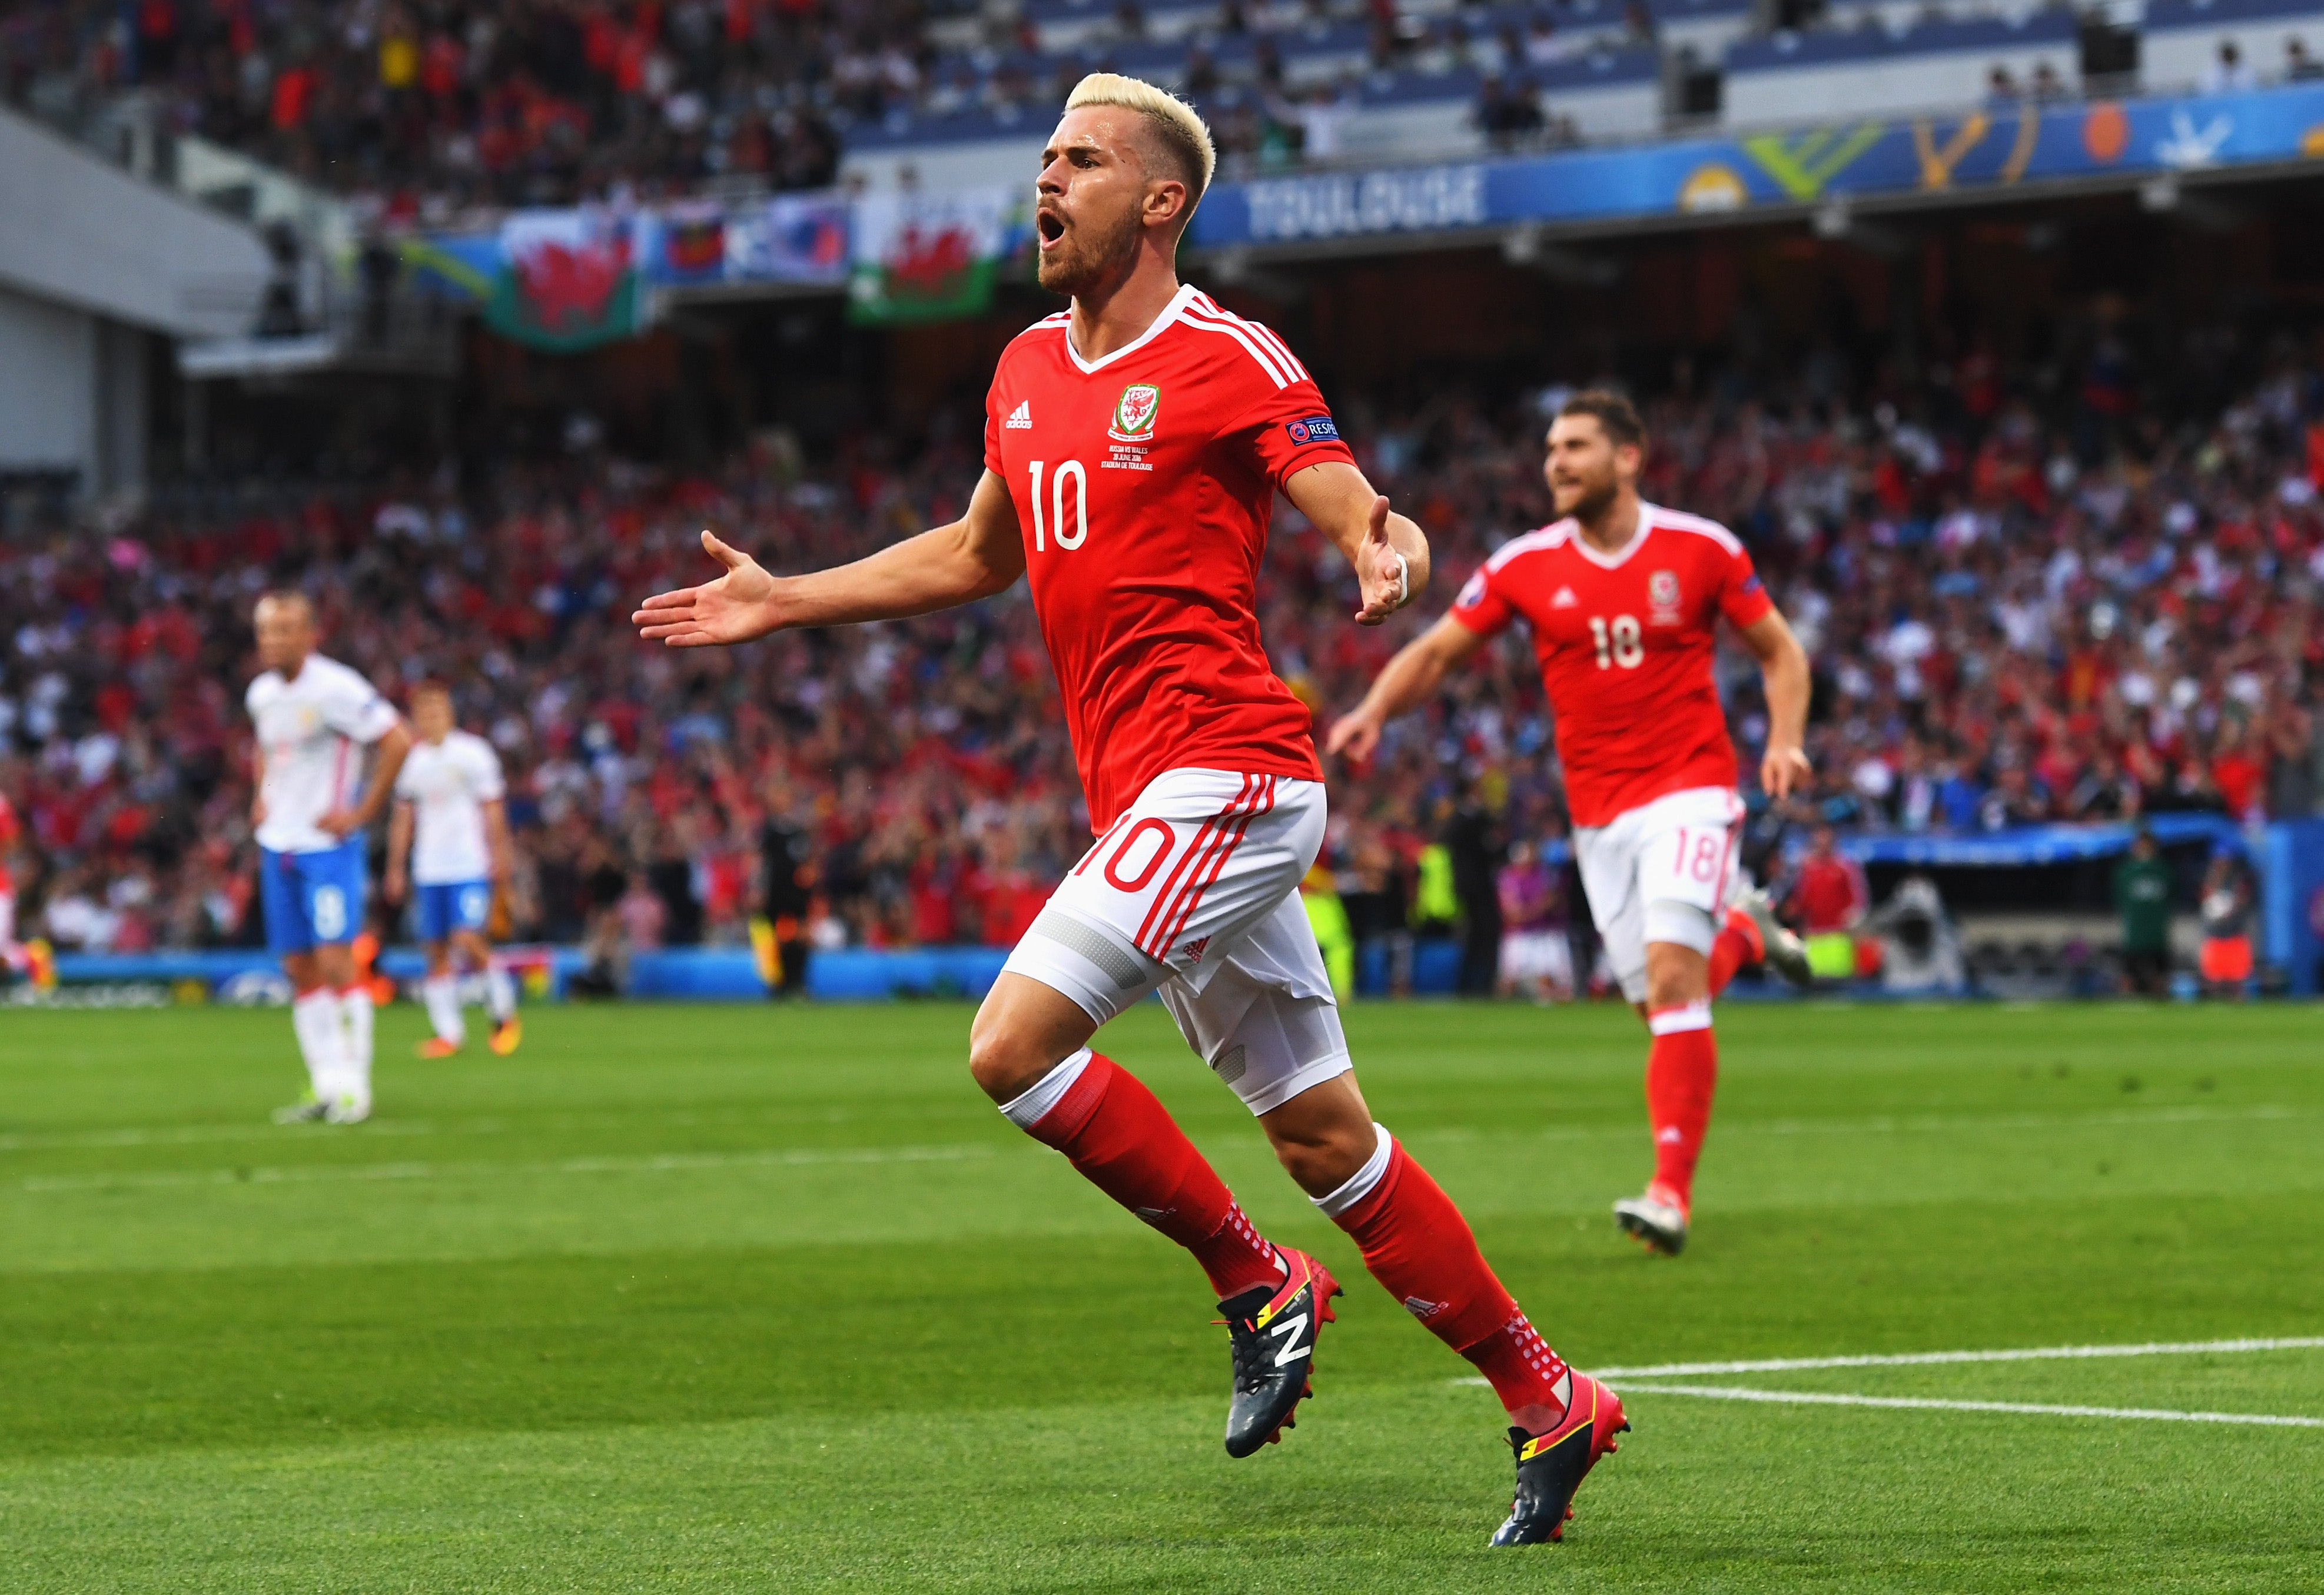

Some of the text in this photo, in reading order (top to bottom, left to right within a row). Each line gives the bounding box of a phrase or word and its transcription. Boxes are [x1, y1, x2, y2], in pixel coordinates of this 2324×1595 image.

[1247, 166, 1487, 240] TOULOUSE
[1005, 418, 1032, 429] adidas
[1131, 446, 1148, 454] WALES
[1128, 462, 1153, 471] TOULOUSE
[1028, 460, 1088, 552] 10
[1589, 613, 1645, 670] 18
[1073, 813, 1176, 893] 10
[1673, 827, 1718, 883] 18
